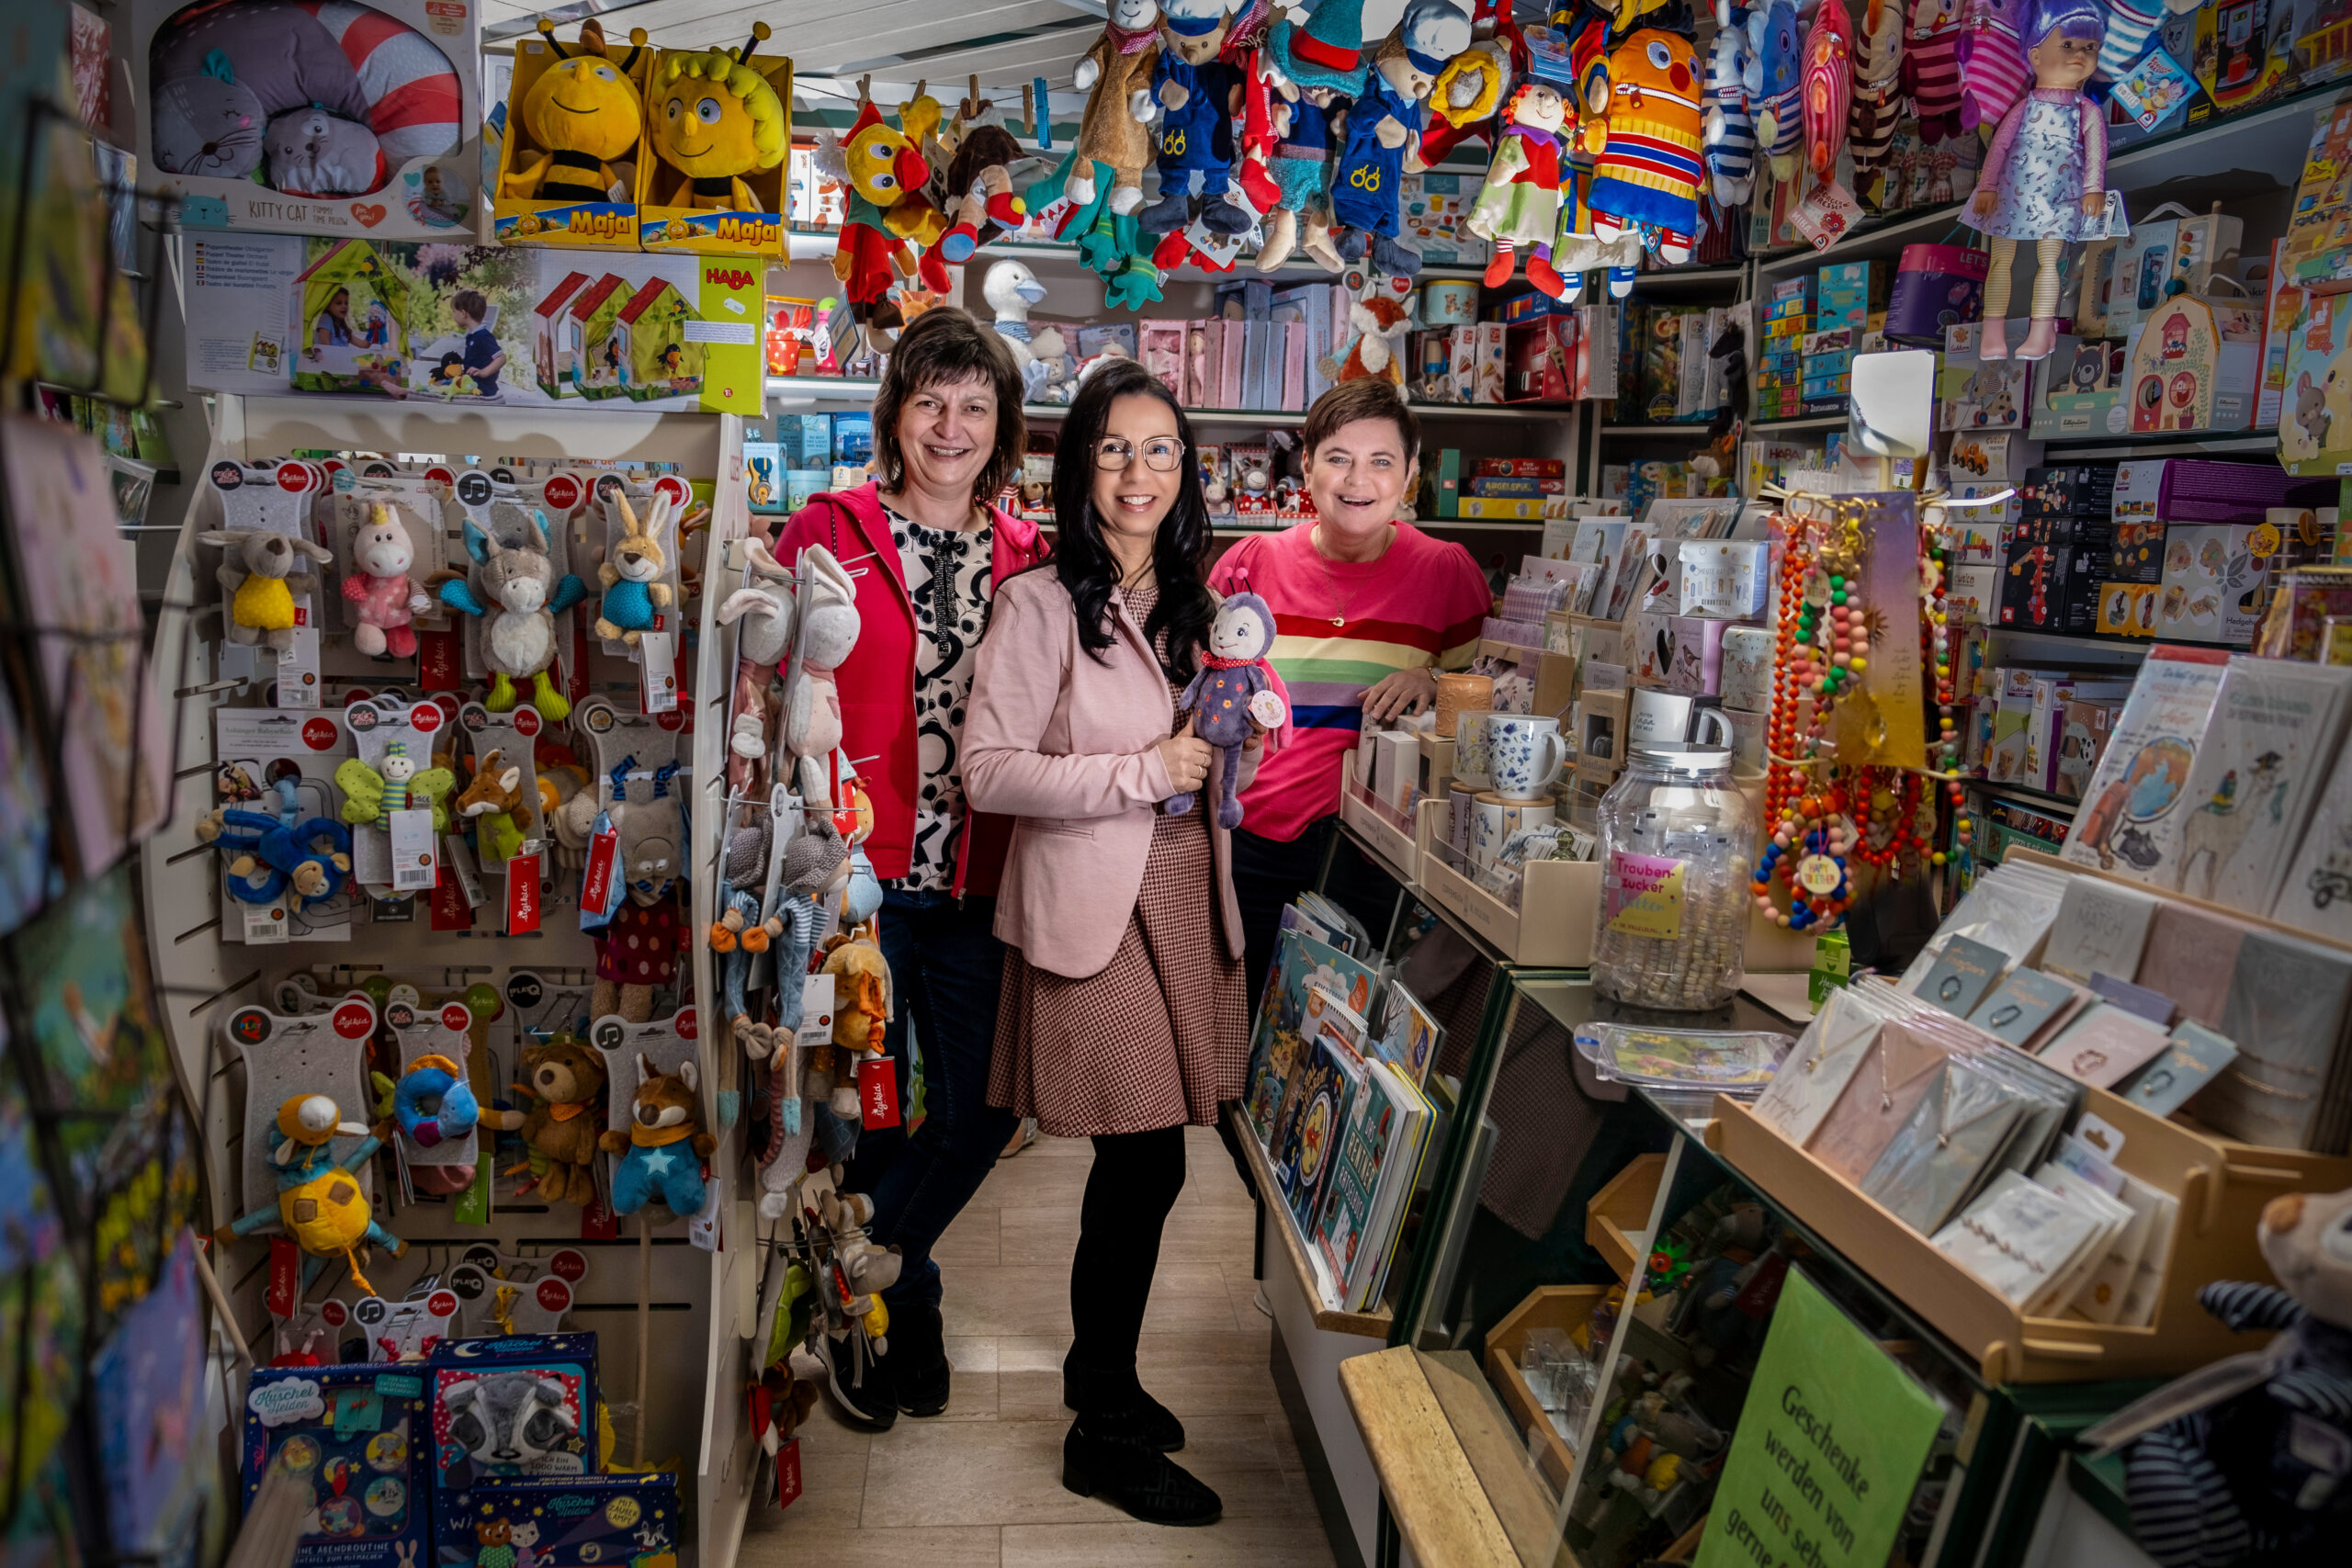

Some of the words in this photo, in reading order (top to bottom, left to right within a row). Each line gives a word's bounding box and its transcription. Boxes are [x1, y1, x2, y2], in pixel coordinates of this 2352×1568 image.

[249, 199, 282, 220] KITTY
[287, 205, 307, 222] CAT
[312, 215, 326, 224] TIME
[328, 216, 348, 226] PILLOW
[569, 210, 630, 239] Maja
[717, 217, 776, 246] Maja
[706, 268, 754, 290] HABA
[548, 487, 575, 499] sigikid
[414, 713, 439, 724] sigikid
[306, 728, 335, 741] sigikid
[1616, 857, 1675, 878] Trauben-
[590, 859, 605, 903] sigikid
[1622, 878, 1664, 894] zucker
[517, 881, 530, 922] sigikid
[336, 1017, 369, 1031] sigikid
[873, 1083, 886, 1122] sigikid
[540, 1290, 568, 1303] sigikid
[429, 1300, 455, 1310] sigikid
[254, 1387, 314, 1407] Kuschel
[267, 1401, 309, 1415] Helden
[1781, 1385, 1870, 1504] Geschenke
[1765, 1429, 1825, 1512] werden
[1826, 1503, 1856, 1555] von
[547, 1495, 595, 1509] Kuschel
[617, 1498, 633, 1507] MIT
[558, 1506, 591, 1517] Helden
[608, 1504, 639, 1517] ZAUBER
[1760, 1487, 1792, 1537] uns
[608, 1513, 632, 1525] LAMPE
[1724, 1508, 1773, 1568] gerne
[296, 1544, 314, 1555] INE
[318, 1542, 390, 1553] ABENDROUTINE
